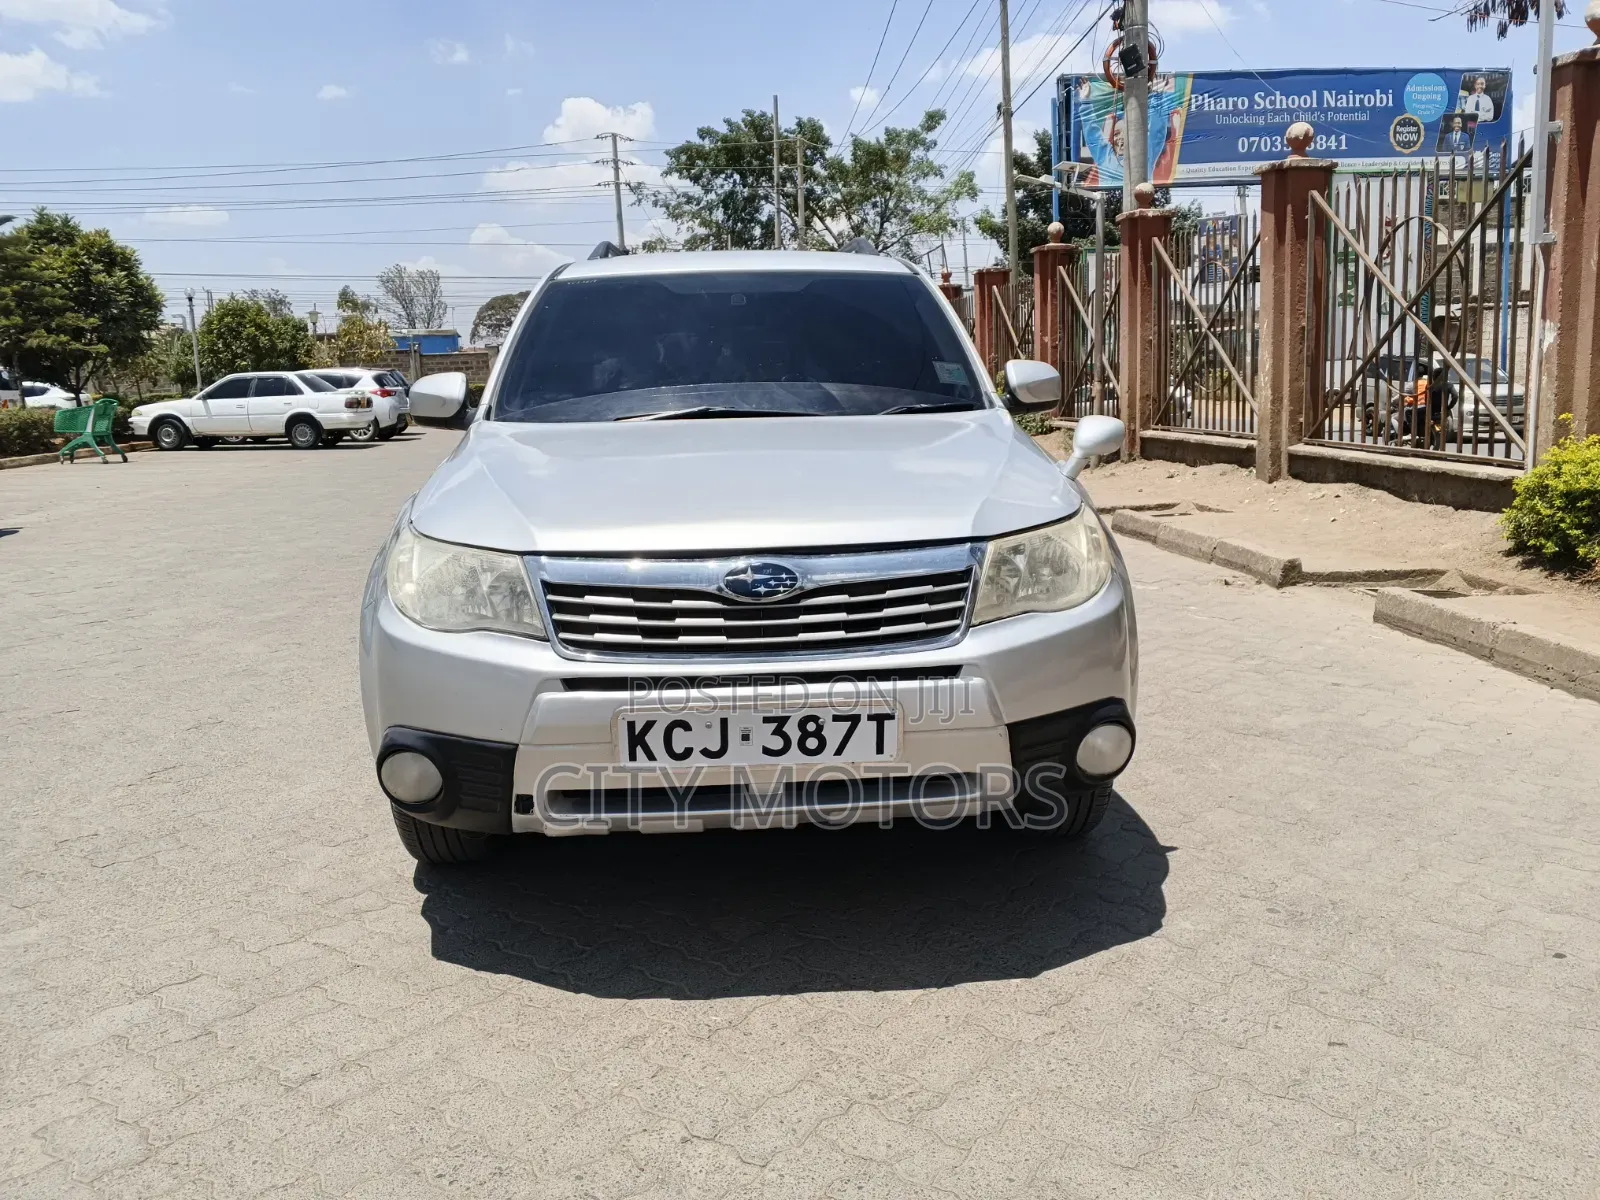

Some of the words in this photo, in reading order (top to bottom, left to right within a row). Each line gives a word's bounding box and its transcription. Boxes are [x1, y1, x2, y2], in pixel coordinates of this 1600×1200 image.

[1406, 84, 1446, 92] Admissions
[1190, 93, 1249, 111] Pharo
[1254, 91, 1318, 110] School
[1323, 89, 1394, 108] Nairobi
[1412, 92, 1442, 101] Ongoing
[1215, 113, 1265, 125] Unlocking
[1267, 112, 1290, 123] Each
[1292, 111, 1325, 122] Child's
[1327, 110, 1370, 121] Potential
[1396, 125, 1418, 134] Register
[1396, 133, 1418, 142] NOW
[1362, 160, 1393, 168] Leadership
[627, 717, 729, 763] KCJ
[761, 713, 896, 759] 387T
